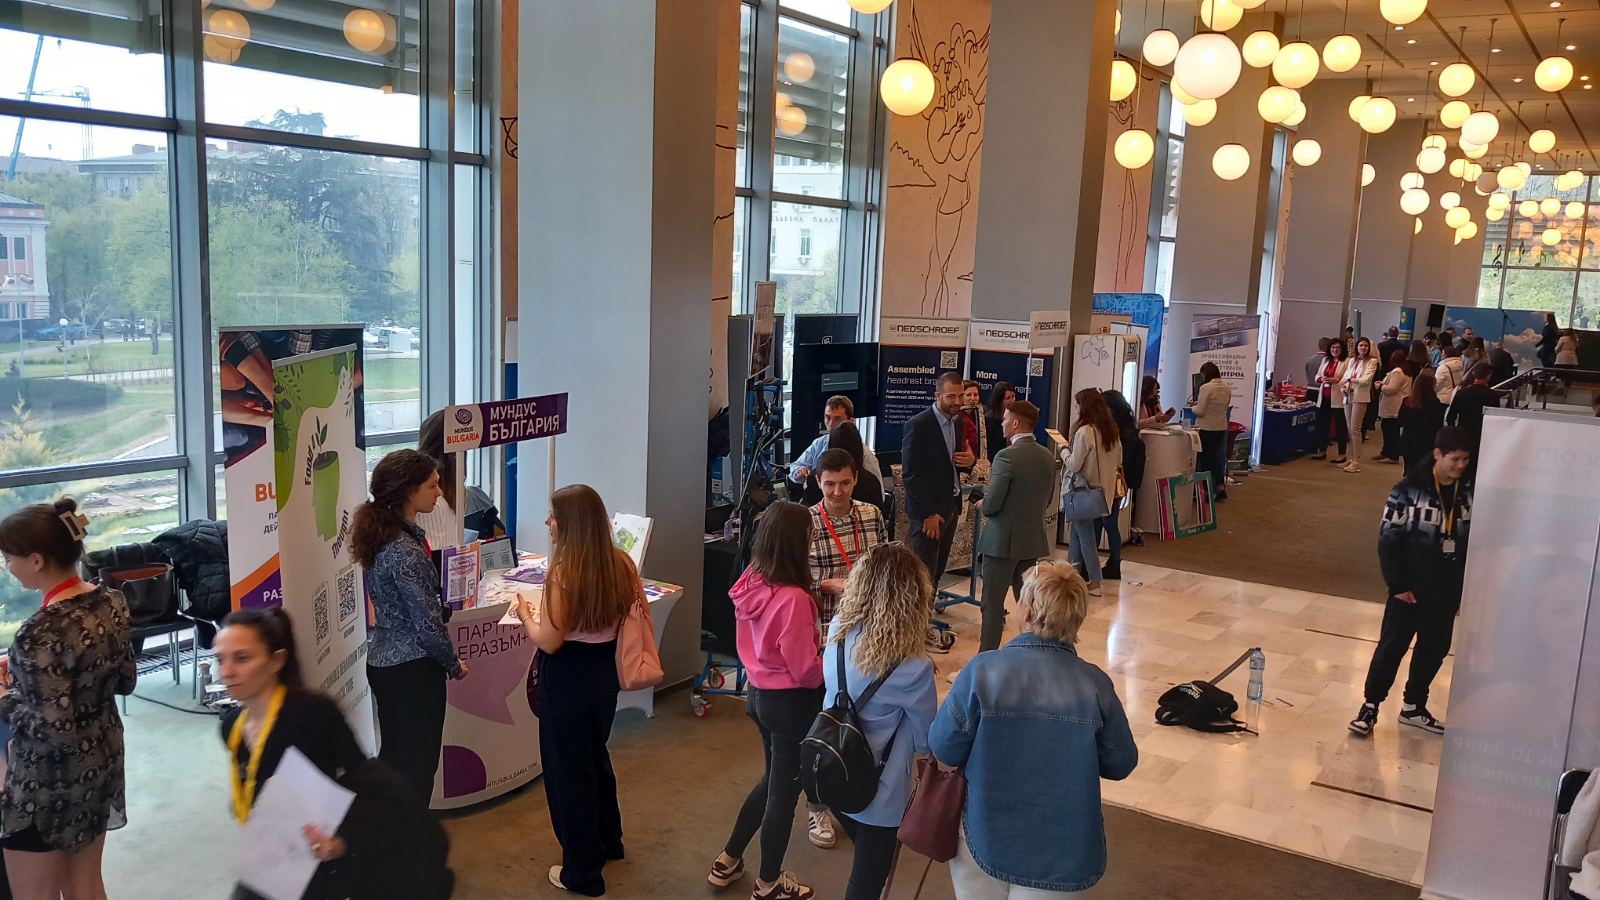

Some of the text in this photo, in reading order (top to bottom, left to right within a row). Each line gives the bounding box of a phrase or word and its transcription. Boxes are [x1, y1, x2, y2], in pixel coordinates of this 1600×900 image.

[896, 324, 960, 334] NEDSCHROEF
[985, 329, 1030, 339] NEDSCHR
[888, 365, 936, 374] Assembled
[976, 370, 998, 380] More
[886, 376, 922, 385] headrest
[979, 382, 993, 391] han
[490, 402, 537, 421] МУНДУС
[489, 414, 560, 442] БЪЛГАРИЯ
[446, 433, 480, 444] BULGARIA
[255, 482, 278, 502] BU
[268, 511, 279, 520] ПА
[263, 521, 279, 535] ДЕЙ
[263, 588, 283, 602] РАЗ
[457, 632, 529, 661] ЕРАЗЪМ+
